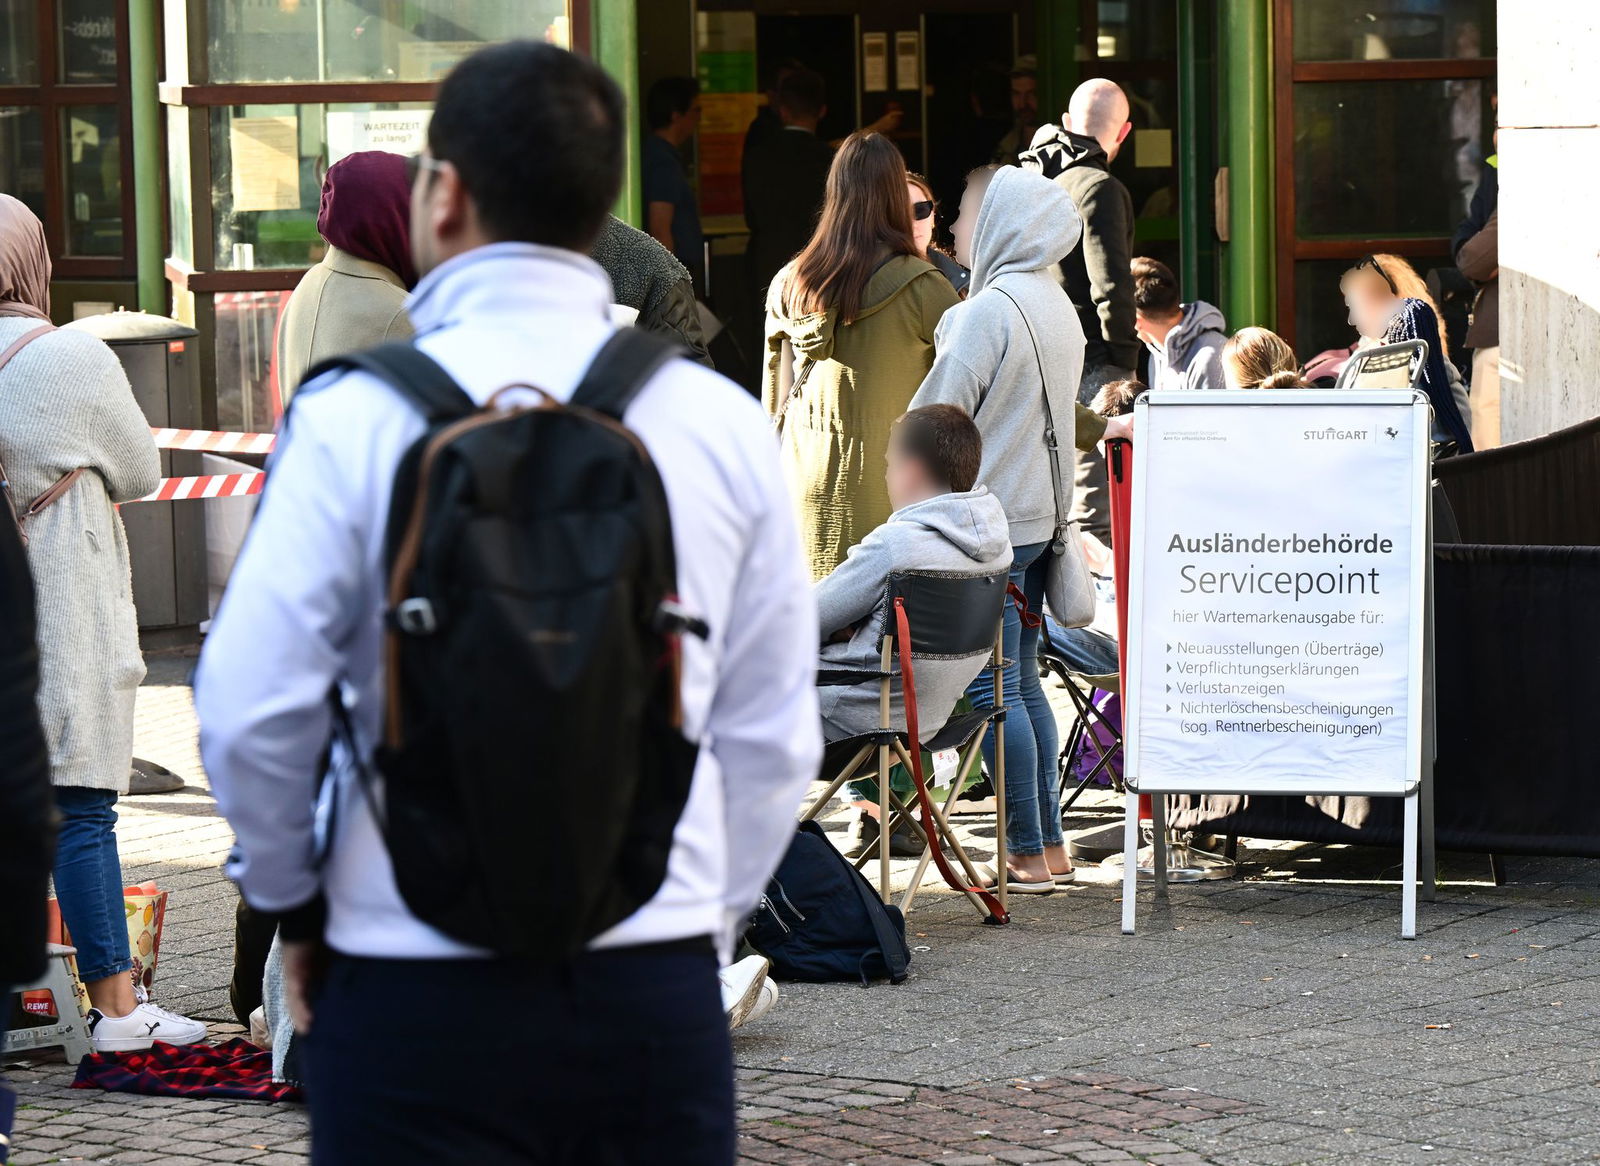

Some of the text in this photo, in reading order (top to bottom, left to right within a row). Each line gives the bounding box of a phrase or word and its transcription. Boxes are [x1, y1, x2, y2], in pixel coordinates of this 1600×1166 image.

[363, 122, 420, 131] WARTEZEIT
[386, 133, 412, 144] lang?
[1303, 430, 1368, 440] STUTTGART
[1167, 532, 1393, 554] Ausländerbehörde
[1180, 564, 1380, 602] Servicepoint
[1173, 609, 1384, 627] hier Wartemarkenausgabe für:
[1177, 640, 1384, 659] Neuausstellungen (Überträge)
[1176, 660, 1360, 679] Verpflichtungserklärungen
[1176, 681, 1285, 698] Verlustanzeigen
[1181, 700, 1394, 719] Nichterlöschensbescheinigungen
[1180, 719, 1383, 738] (sog. Rentnerbescheinigungen)
